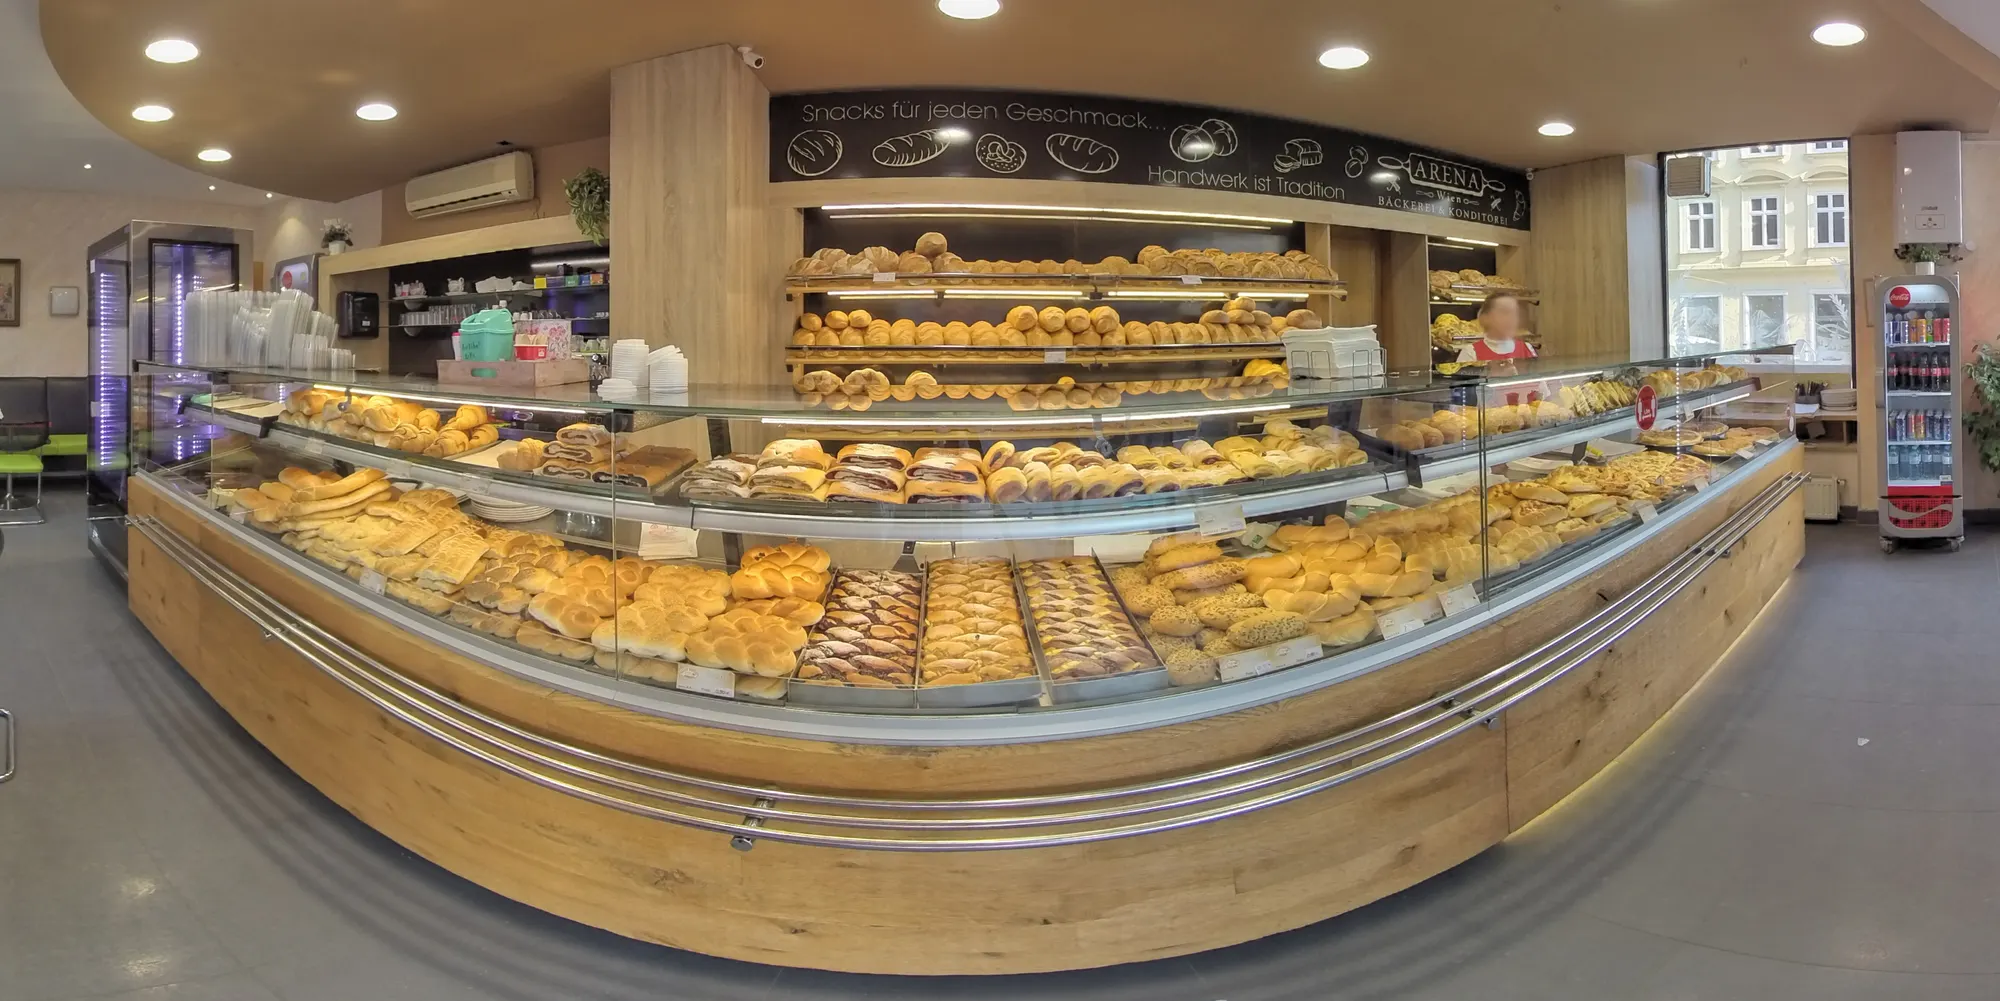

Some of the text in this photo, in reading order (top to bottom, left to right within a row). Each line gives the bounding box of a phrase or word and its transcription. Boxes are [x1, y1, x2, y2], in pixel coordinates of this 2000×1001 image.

[802, 100, 1167, 131] Snacks für jeden Geschmack...
[1148, 165, 1345, 200] Handwerk ist Tradition
[1414, 161, 1480, 191] ARENA
[1378, 195, 1436, 214] BÄCKEREI
[1448, 207, 1508, 226] KONDITOREI
[1436, 190, 1462, 204] Wien
